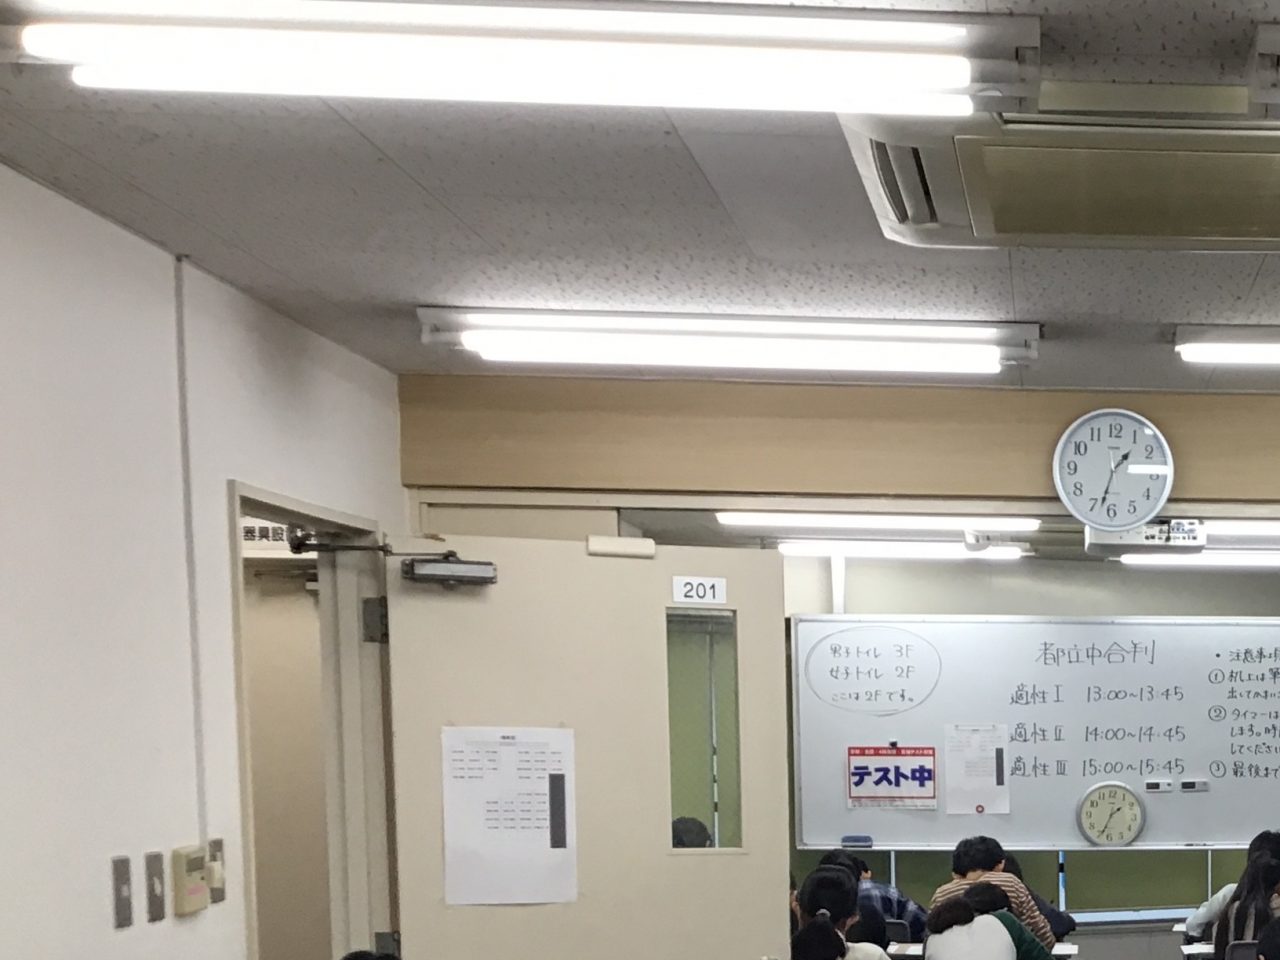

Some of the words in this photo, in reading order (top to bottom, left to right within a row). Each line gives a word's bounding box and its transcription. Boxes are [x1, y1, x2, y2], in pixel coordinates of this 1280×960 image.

[1089, 427, 1101, 442] 11
[1108, 423, 1123, 438] 12
[1131, 429, 1138, 444] 1
[1073, 441, 1088, 456] 10
[1144, 444, 1154, 459] 2
[1066, 460, 1078, 475] 9
[1072, 482, 1083, 496] 8
[1142, 488, 1151, 500] 4
[1088, 498, 1099, 512] 7
[1106, 504, 1117, 518] 6
[1127, 500, 1137, 514] 5
[243, 526, 289, 541] 器具設
[683, 582, 716, 599] 201
[829, 643, 882, 659] 男子トイレ
[892, 644, 915, 659] 3F
[1034, 639, 1156, 666] 都立中合判
[829, 665, 884, 680] 女子トイレ
[894, 665, 915, 680] 2F
[851, 764, 932, 787] テスト中
[1108, 790, 1117, 799] 12
[1090, 800, 1098, 808] 10
